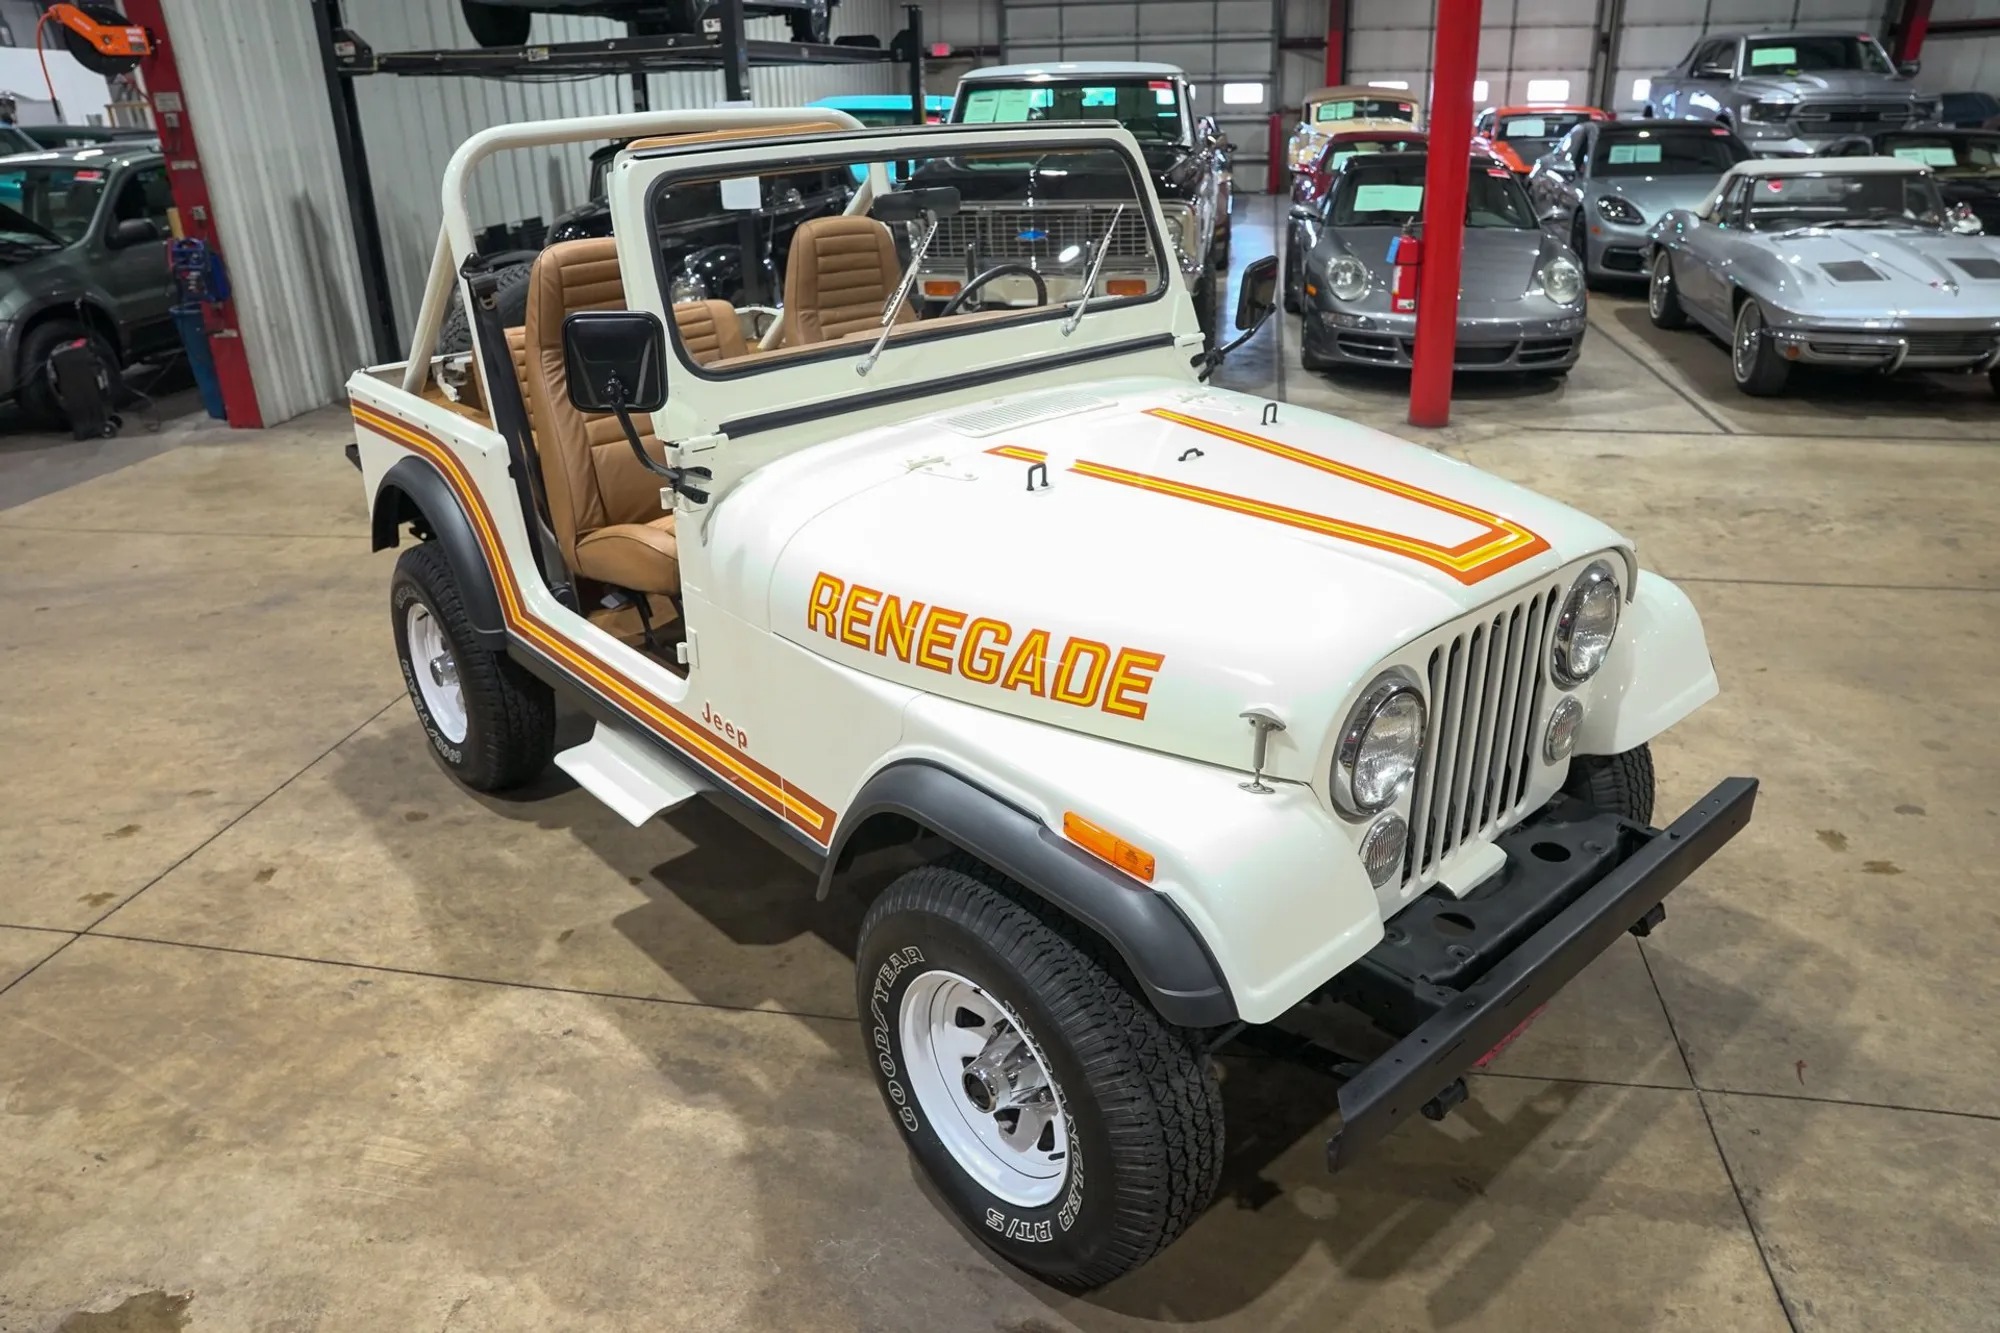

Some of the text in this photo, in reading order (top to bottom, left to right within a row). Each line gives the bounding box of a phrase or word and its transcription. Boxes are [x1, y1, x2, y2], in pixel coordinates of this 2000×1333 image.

[808, 571, 1165, 720] RENEGADE
[702, 701, 748, 749] Jeep
[871, 946, 925, 1132] GOODYEAR
[986, 1207, 1053, 1242] RT/S
